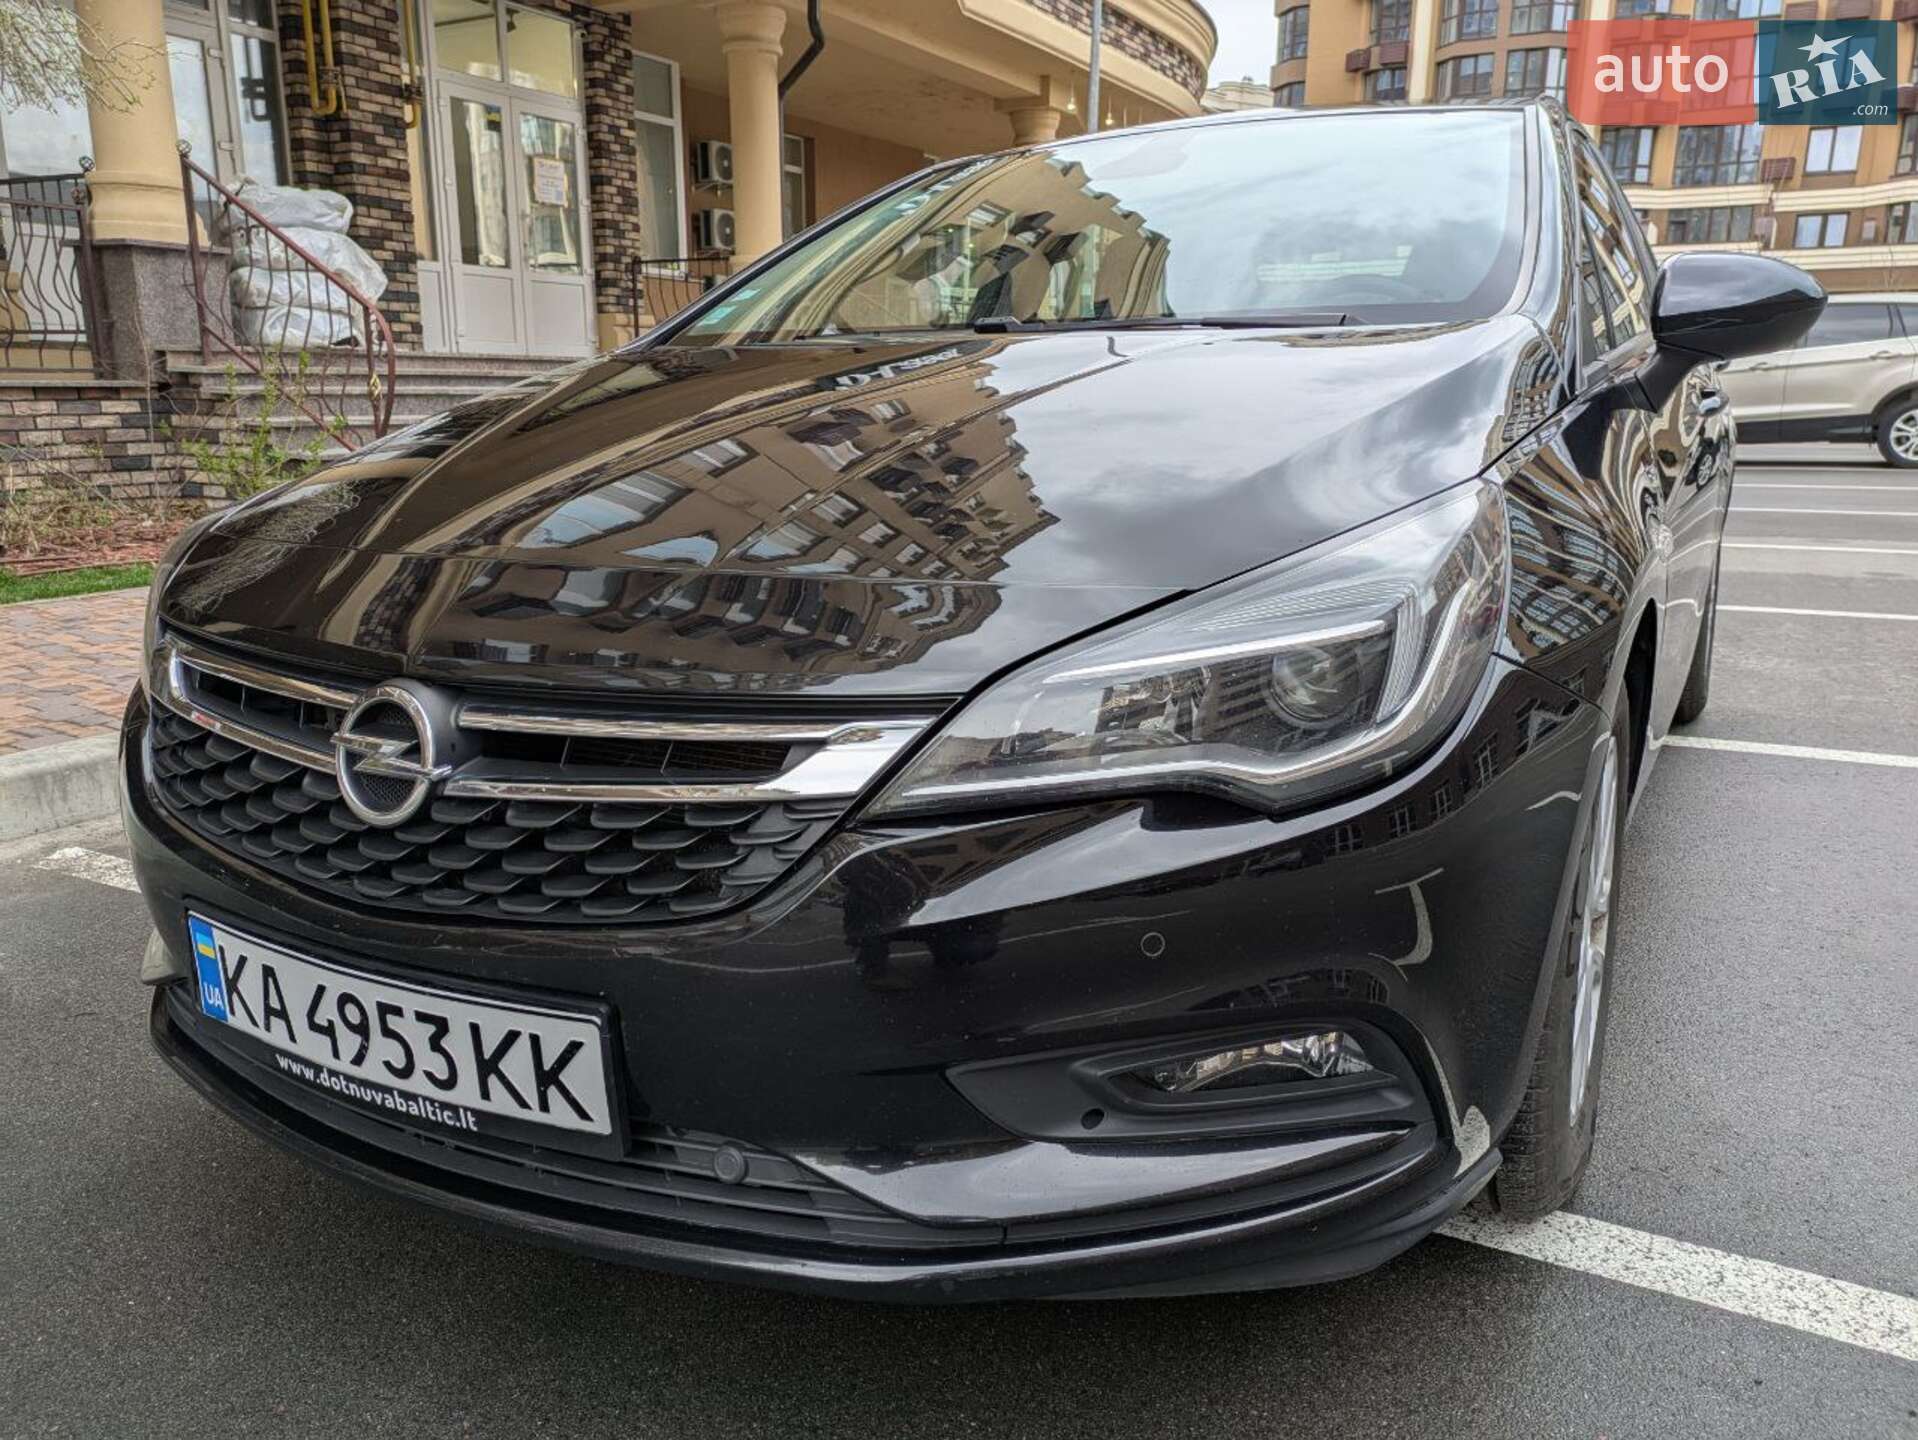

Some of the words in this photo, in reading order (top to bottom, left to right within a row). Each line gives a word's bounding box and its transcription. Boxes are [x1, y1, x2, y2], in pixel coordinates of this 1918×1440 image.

[204, 982, 226, 1012] UA
[219, 943, 297, 1044] KA
[306, 985, 457, 1092] 4953
[470, 1022, 594, 1123] KK
[275, 1054, 478, 1132] www.dotnuvabaltic.lt
